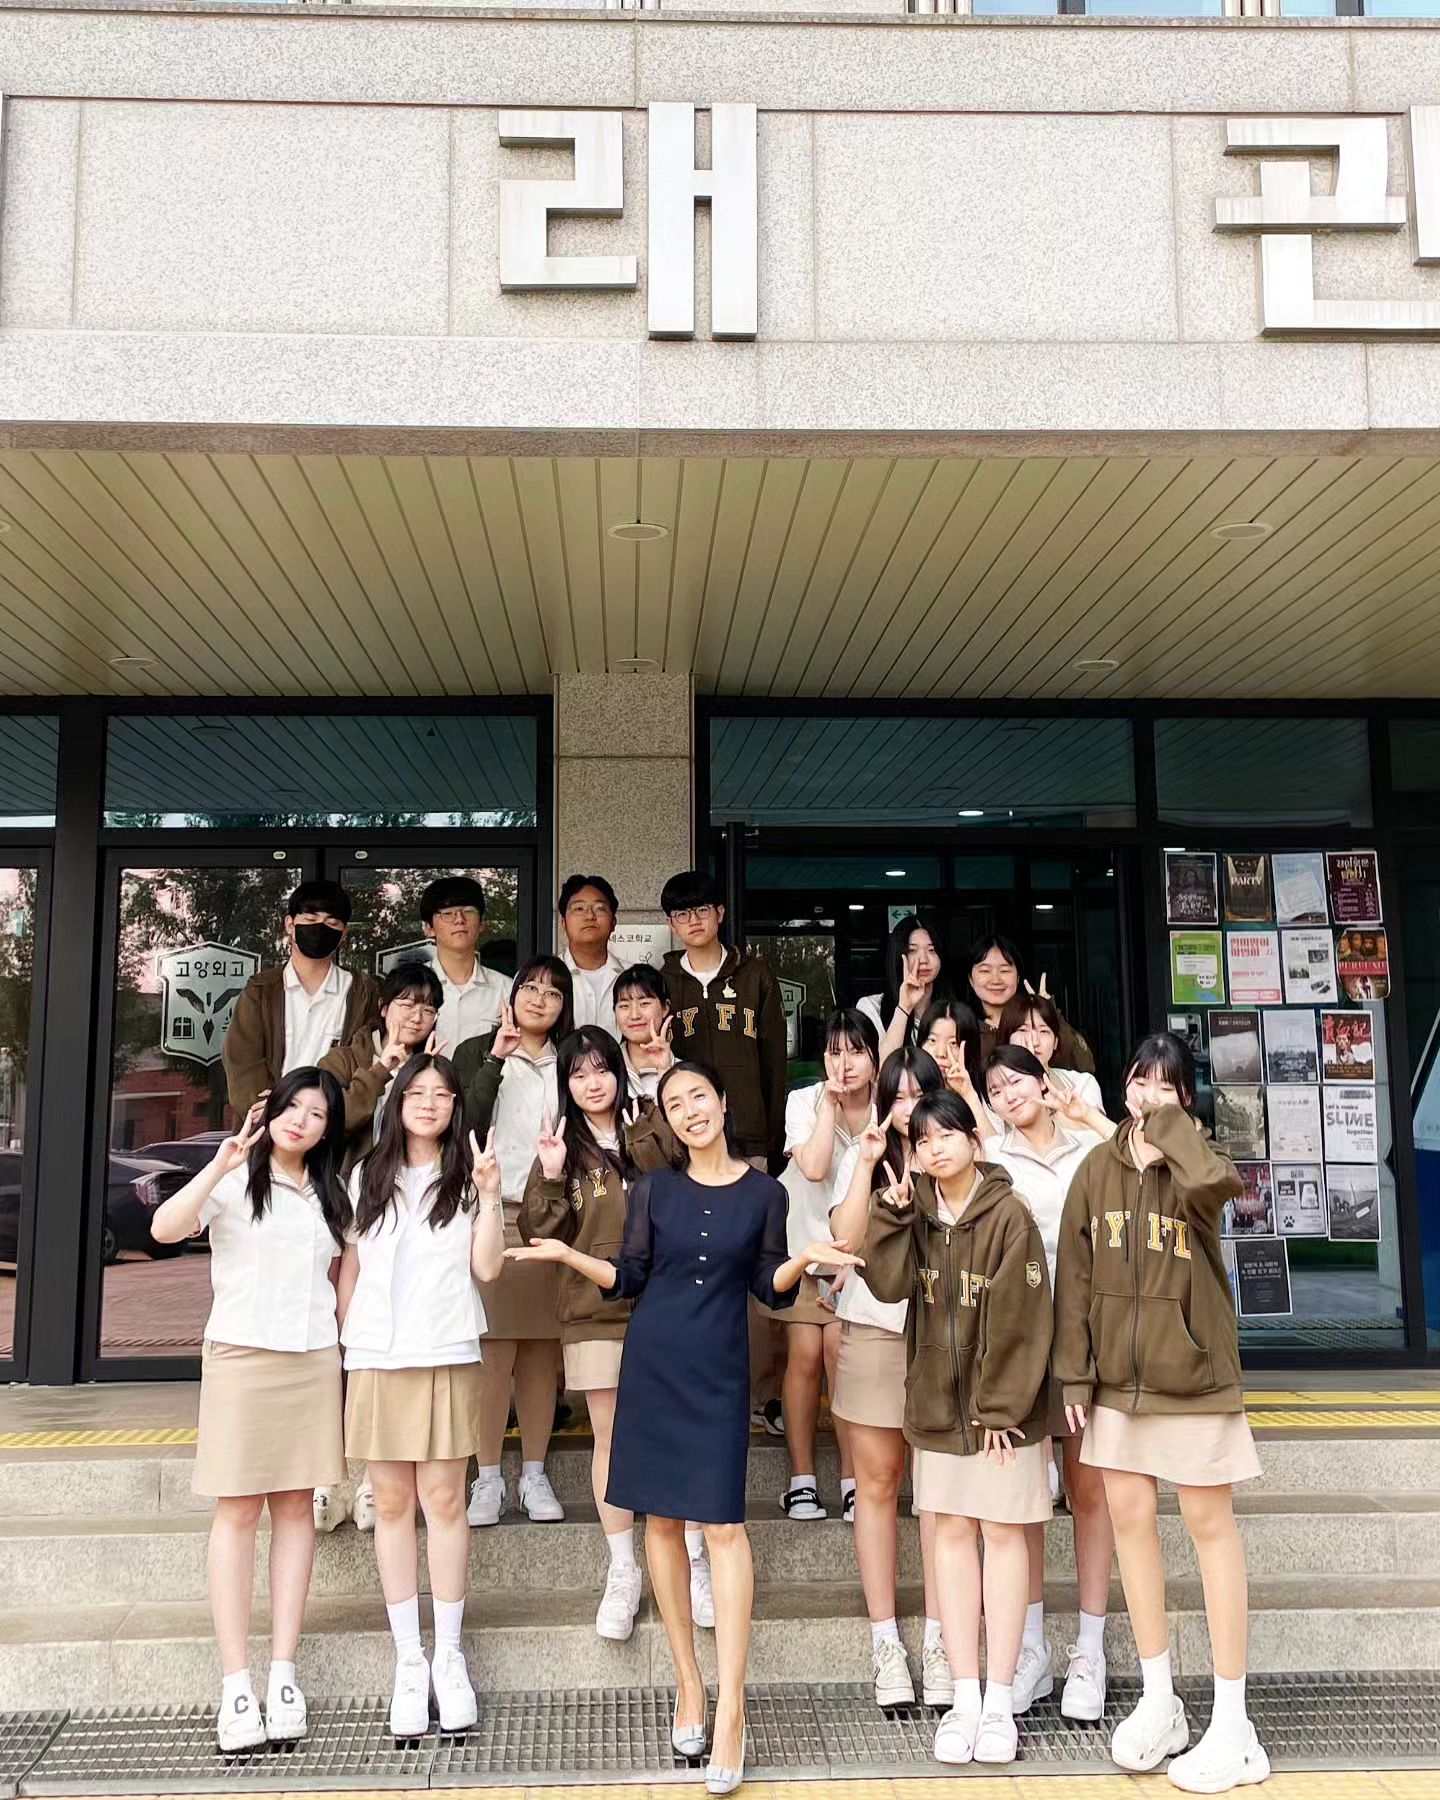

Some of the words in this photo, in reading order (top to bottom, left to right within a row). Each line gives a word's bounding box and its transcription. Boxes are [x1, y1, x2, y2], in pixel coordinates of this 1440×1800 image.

[175, 961, 245, 979] 고양외고
[1326, 1112, 1374, 1127] SLIME
[281, 1685, 295, 1704] C
[234, 1695, 249, 1714] C
